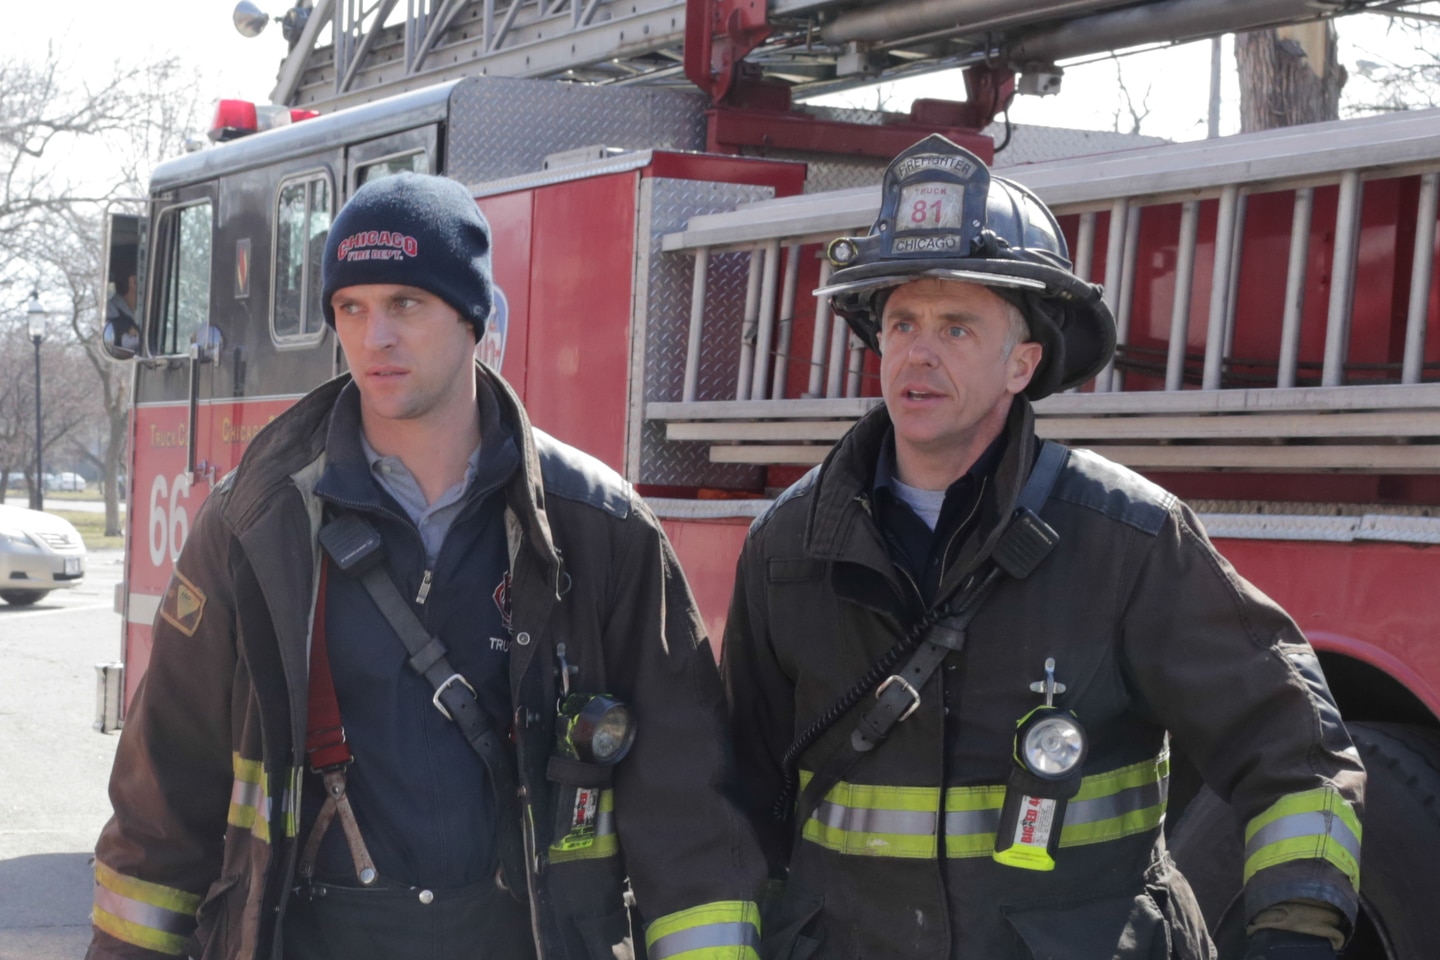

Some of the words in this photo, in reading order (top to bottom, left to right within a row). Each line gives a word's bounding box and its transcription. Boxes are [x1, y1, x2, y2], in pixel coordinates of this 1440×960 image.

[898, 156, 971, 177] FIREFIGHTER
[915, 186, 947, 195] TRUCK
[911, 199, 943, 224] 81
[337, 230, 418, 261] CHICAGO
[896, 236, 957, 252] CHICAGO
[347, 249, 371, 262] FIRE
[371, 248, 404, 261] DEPT.
[149, 473, 191, 567] 66
[1025, 808, 1038, 822] ED
[1021, 825, 1035, 844] BIG
